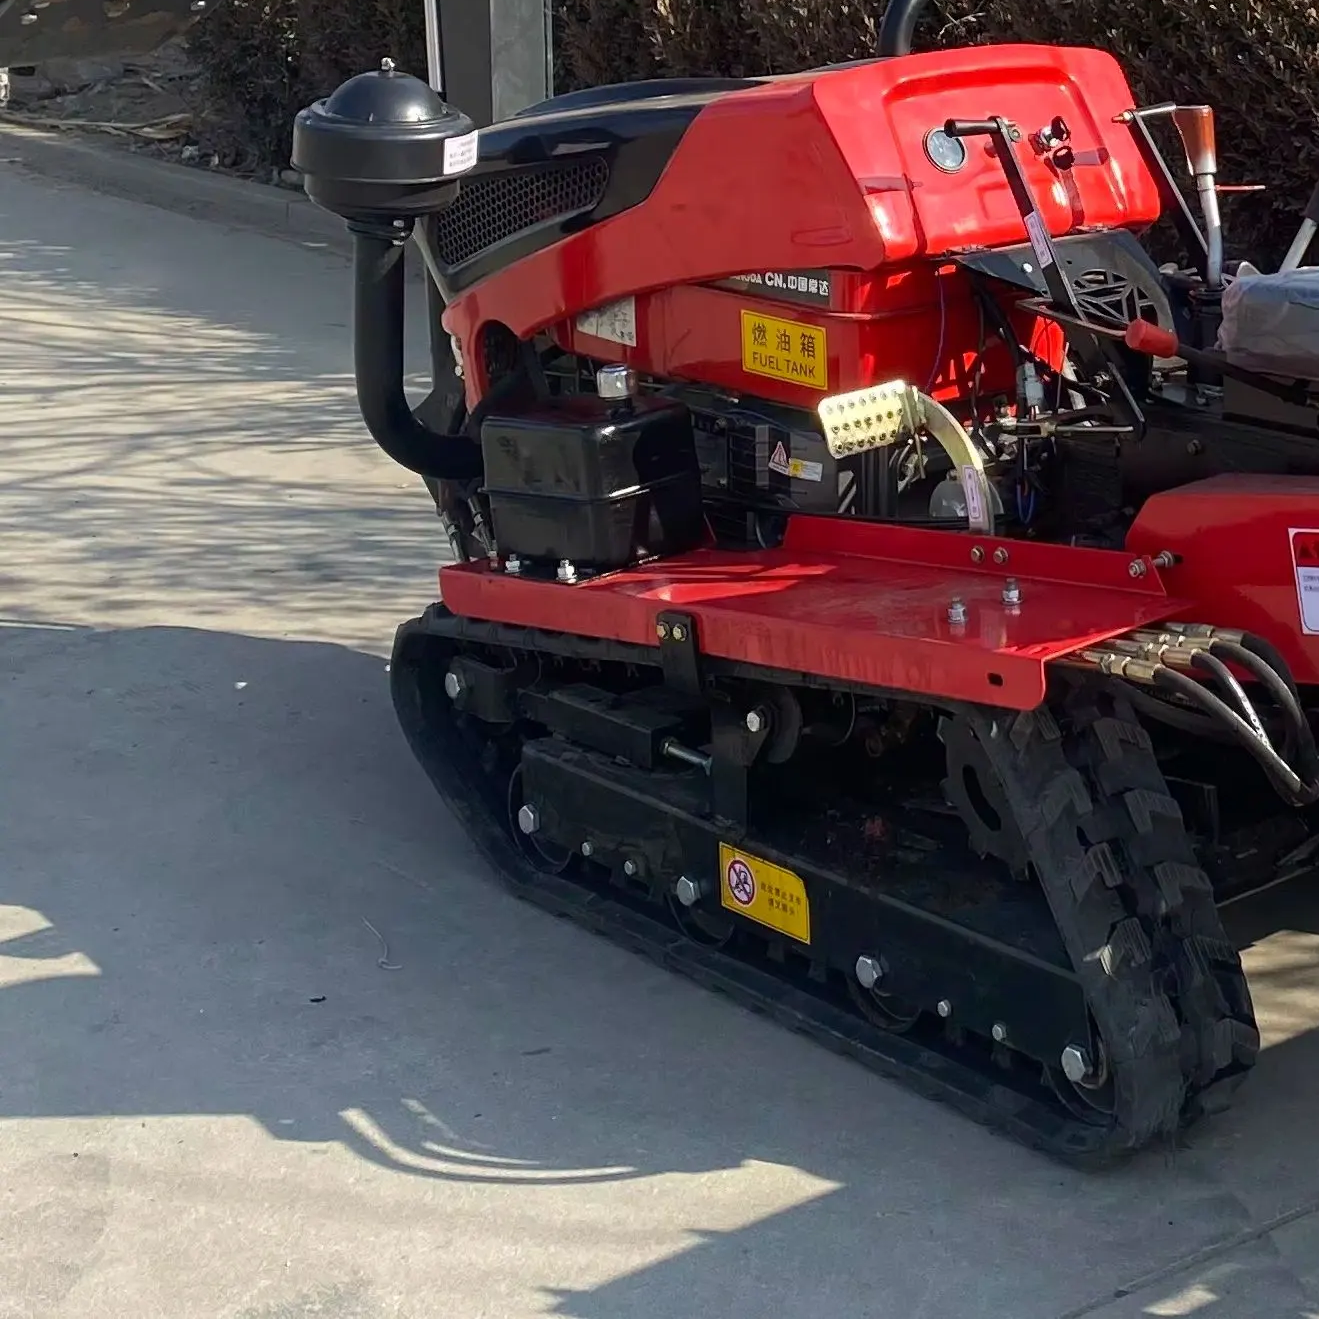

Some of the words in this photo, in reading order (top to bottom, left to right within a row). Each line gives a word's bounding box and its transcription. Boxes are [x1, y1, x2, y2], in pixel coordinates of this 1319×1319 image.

[752, 322, 815, 359] 燃油箱
[752, 351, 782, 372] FUEL
[784, 358, 815, 378] TANK
